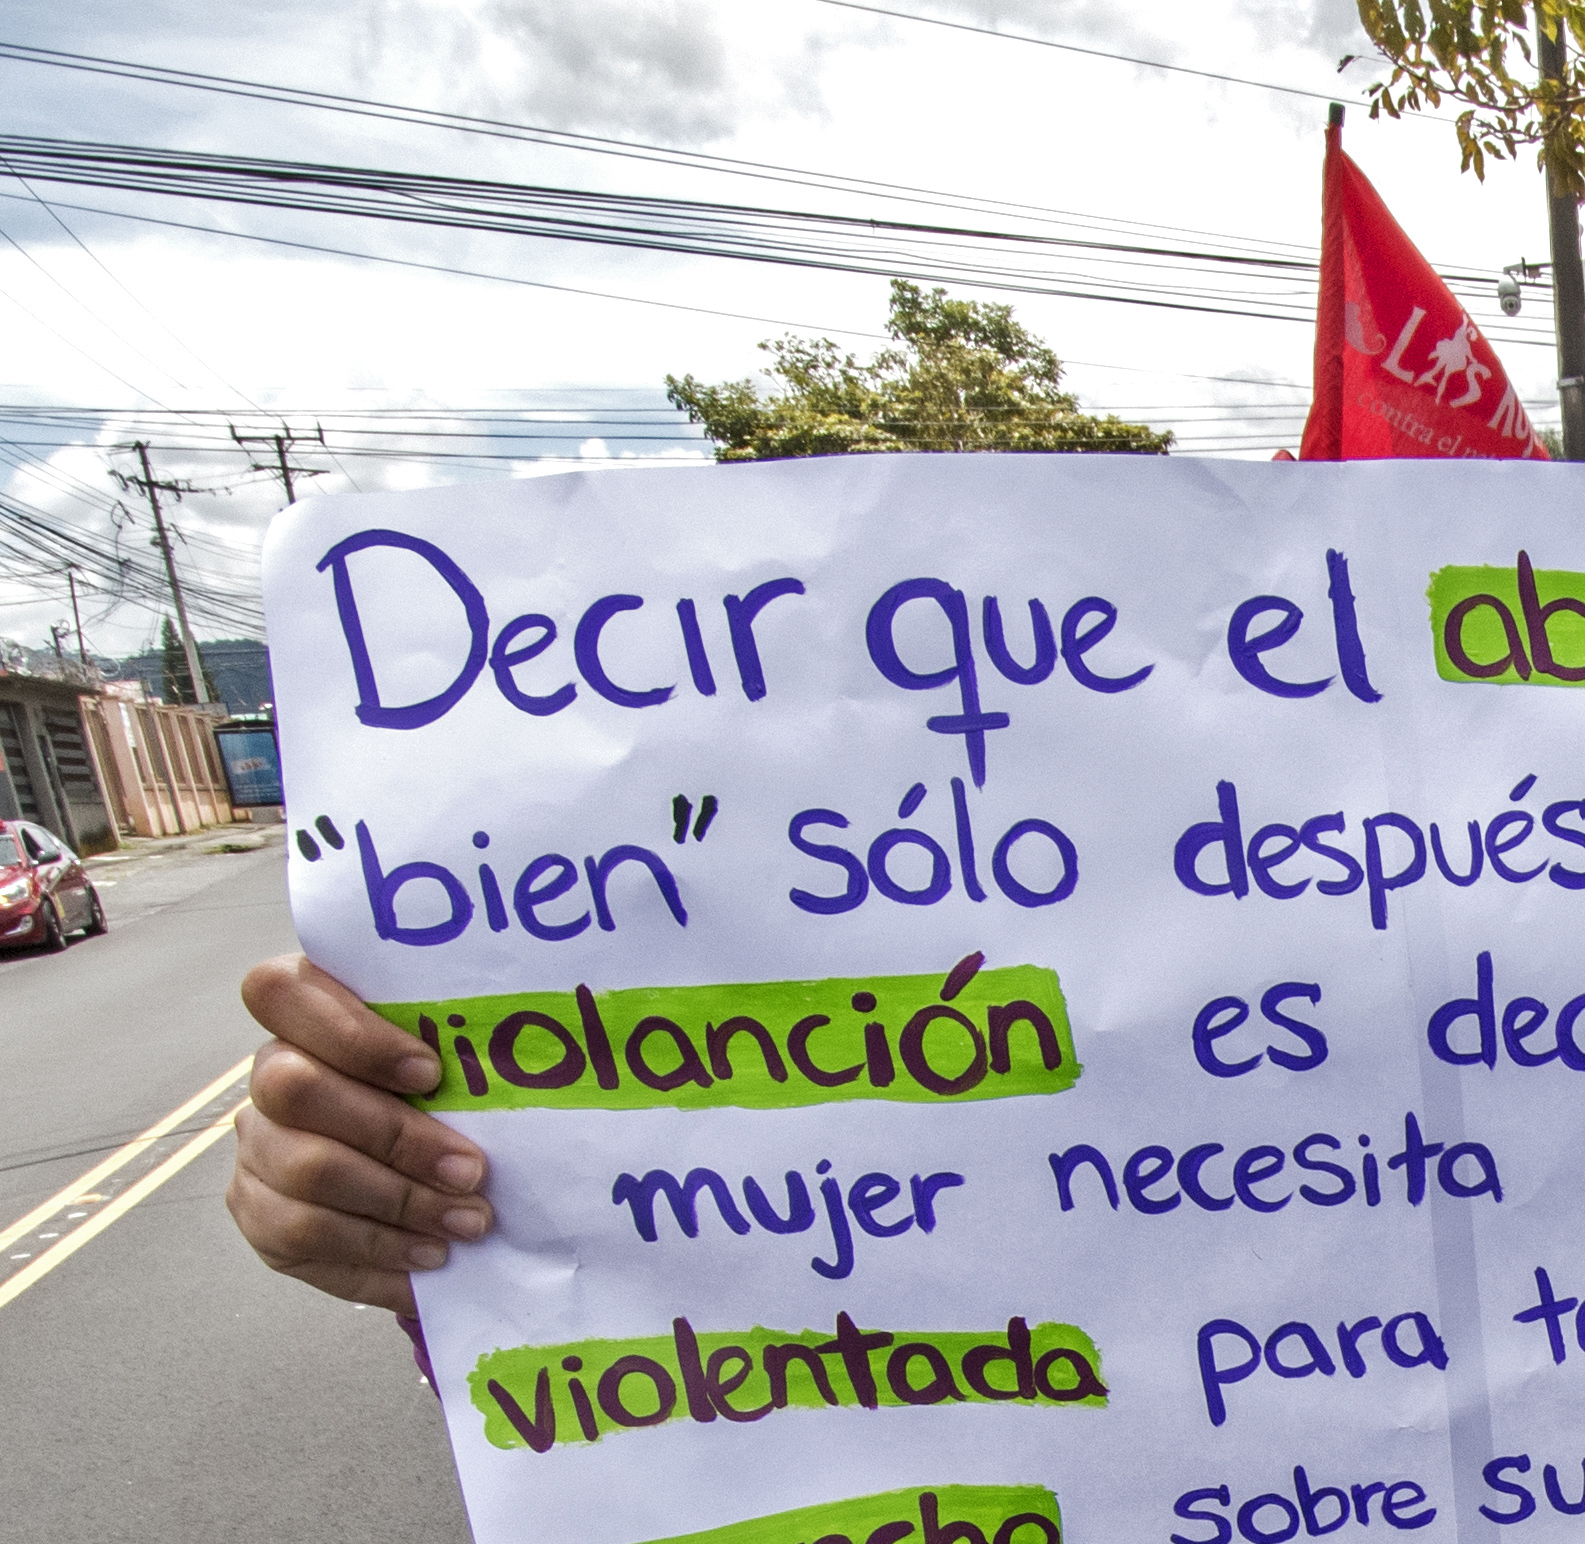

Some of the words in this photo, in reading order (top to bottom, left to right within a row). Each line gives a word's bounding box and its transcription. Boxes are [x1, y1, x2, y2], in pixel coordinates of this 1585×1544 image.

[1357, 391, 1435, 445] contra
[317, 530, 805, 729] Decir
[867, 578, 1153, 788] que
[1228, 550, 1383, 703] el
[297, 794, 718, 946] "bien"
[790, 777, 1078, 915] sólo
[1192, 982, 1328, 1078] es
[613, 1158, 964, 1279] mujer
[1050, 1111, 1504, 1214] necesita
[488, 1311, 1109, 1453] violentada
[1198, 1312, 1449, 1427] para
